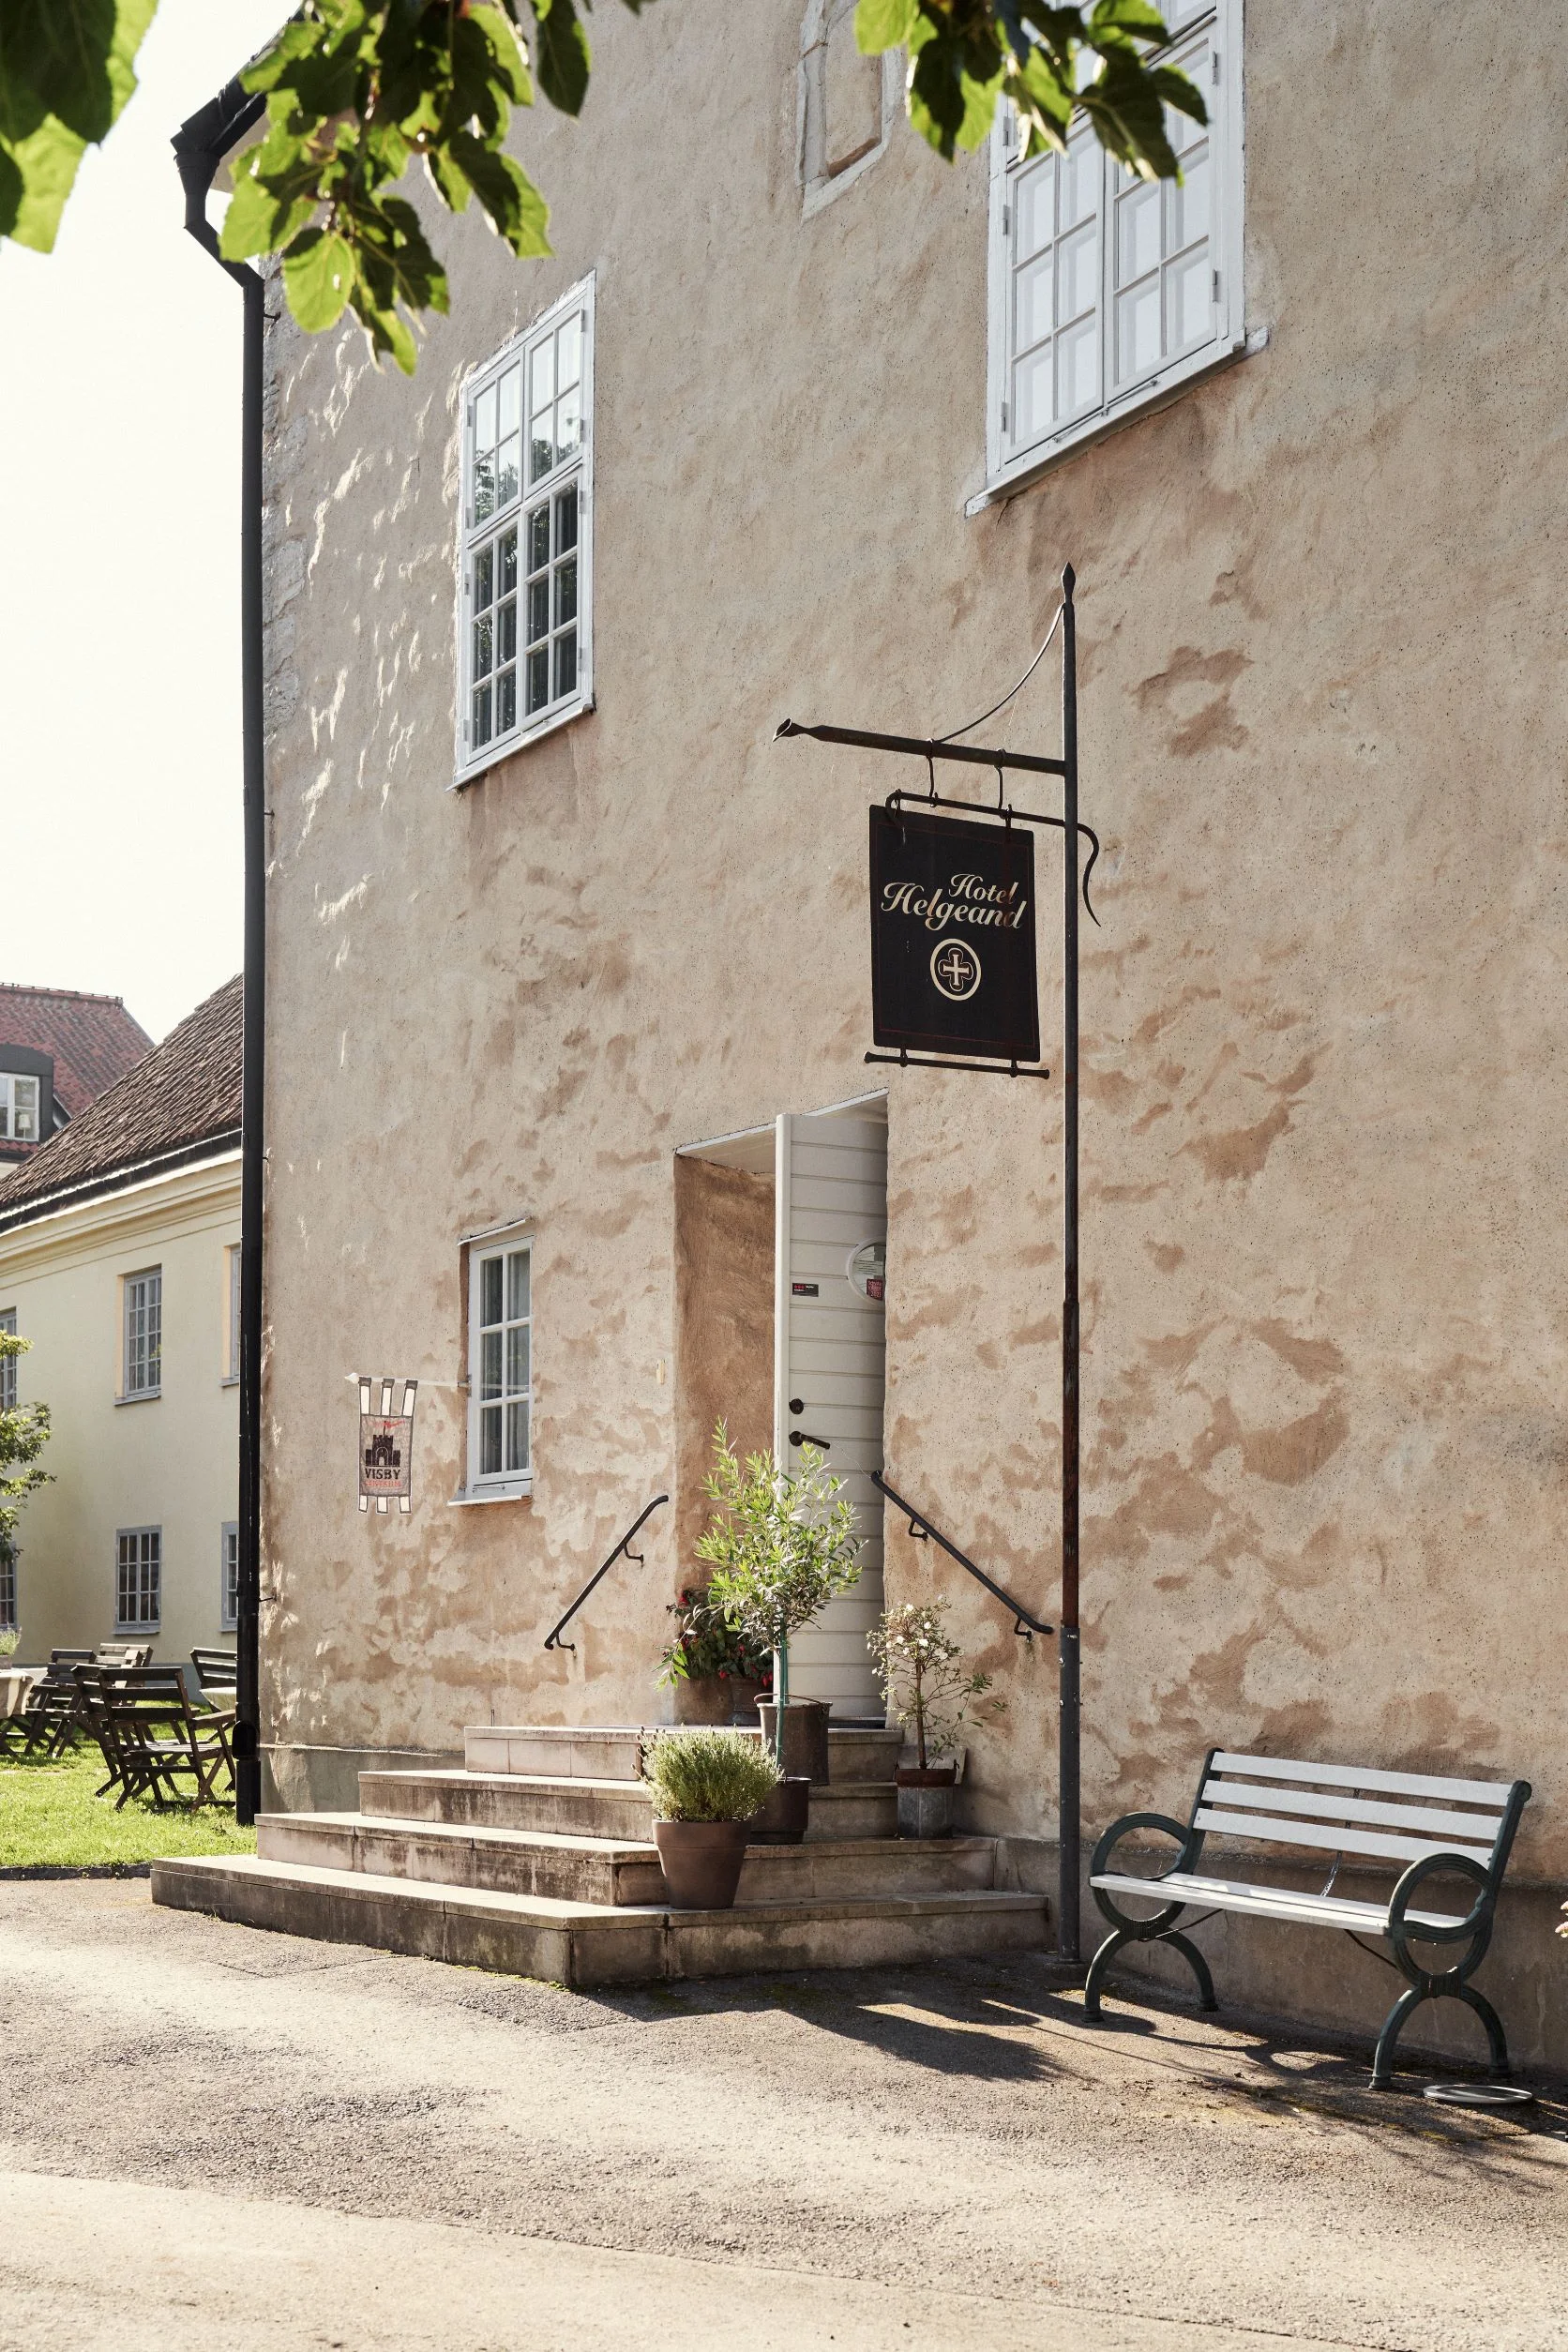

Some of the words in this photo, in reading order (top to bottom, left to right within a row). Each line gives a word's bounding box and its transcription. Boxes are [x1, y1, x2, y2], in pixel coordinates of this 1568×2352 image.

[949, 873, 1018, 904] Hotel
[881, 882, 1027, 930] Helgeand
[365, 1468, 400, 1480] VISBY
